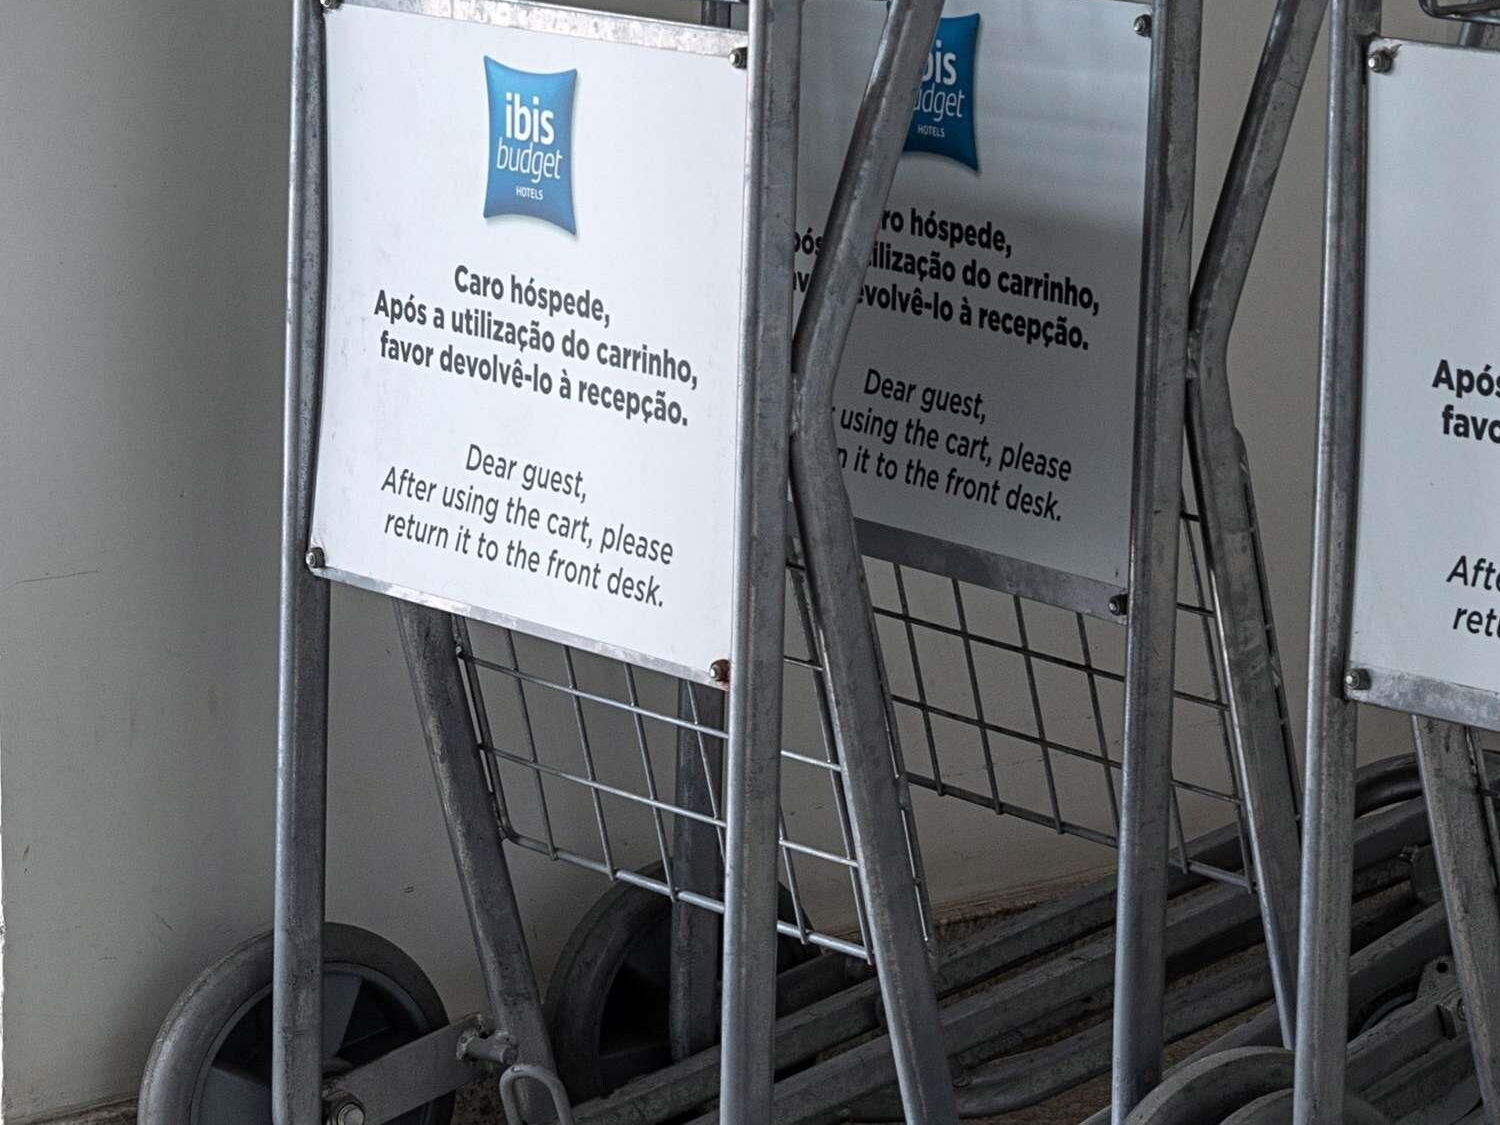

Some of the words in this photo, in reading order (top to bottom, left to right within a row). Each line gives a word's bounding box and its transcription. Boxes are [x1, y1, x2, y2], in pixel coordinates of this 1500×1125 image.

[505, 91, 555, 145] ibis
[496, 136, 563, 184] budget
[516, 186, 543, 200] HOTELS
[909, 207, 1012, 259] hóspede,
[454, 265, 504, 300] Caro
[511, 274, 610, 329] hóspede,
[962, 258, 991, 290] do
[997, 271, 1099, 317] carrinho,
[374, 289, 427, 326] Após
[433, 307, 445, 330] a
[451, 308, 555, 353] utilização
[561, 329, 590, 361] do
[596, 342, 697, 391] carrinho,
[959, 296, 972, 326] à
[978, 307, 1089, 350] recepção.
[380, 330, 434, 368] favor
[440, 344, 553, 395] devolvê-lo
[559, 368, 571, 400] à
[578, 380, 688, 426] recepção.
[863, 368, 917, 403] Dear
[920, 387, 986, 425] guest,
[465, 444, 518, 480] Dear
[521, 464, 586, 504] guest,
[840, 407, 899, 445] using
[904, 418, 939, 450] the
[945, 433, 992, 468] cart,
[998, 442, 1072, 482] please
[853, 445, 871, 474] it
[875, 452, 898, 480] to
[904, 458, 939, 491] the
[945, 467, 1001, 506] front
[1005, 483, 1061, 522] desk.
[381, 466, 437, 502] After
[442, 485, 499, 524] using
[506, 497, 540, 530] the
[547, 513, 592, 549] cart,
[600, 523, 673, 565] please
[384, 514, 449, 553] return
[455, 525, 471, 555] it
[477, 532, 498, 562] to
[506, 540, 540, 573] the
[547, 549, 601, 590] front
[607, 567, 663, 607] desk.
